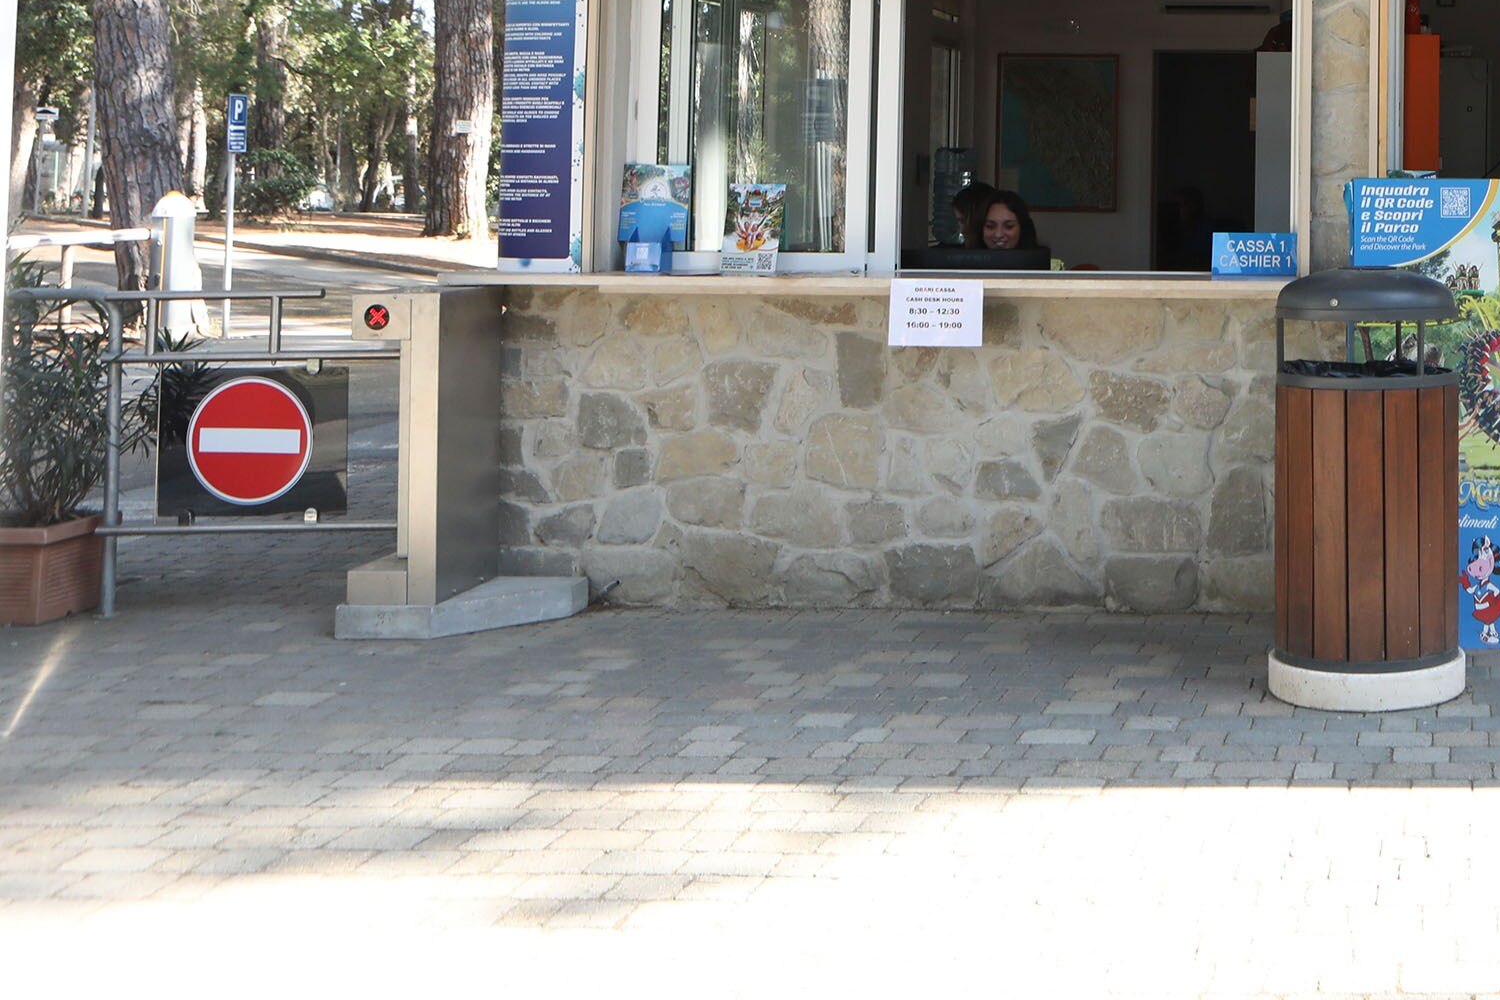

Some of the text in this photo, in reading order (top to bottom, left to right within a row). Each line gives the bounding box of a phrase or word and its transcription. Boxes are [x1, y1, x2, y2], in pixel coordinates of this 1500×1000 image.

[234, 99, 243, 121] P
[1361, 185, 1430, 197] Inquadra
[1361, 197, 1434, 210] il QR Code
[1361, 210, 1424, 222] e Scopri
[1361, 222, 1419, 234] il Parco
[1360, 235, 1415, 243] Scan the QR Code
[1226, 240, 1285, 253] CASSA 1
[1374, 243, 1400, 251] Discover
[1412, 243, 1426, 251] Park
[1219, 255, 1291, 268] CASHIER 1
